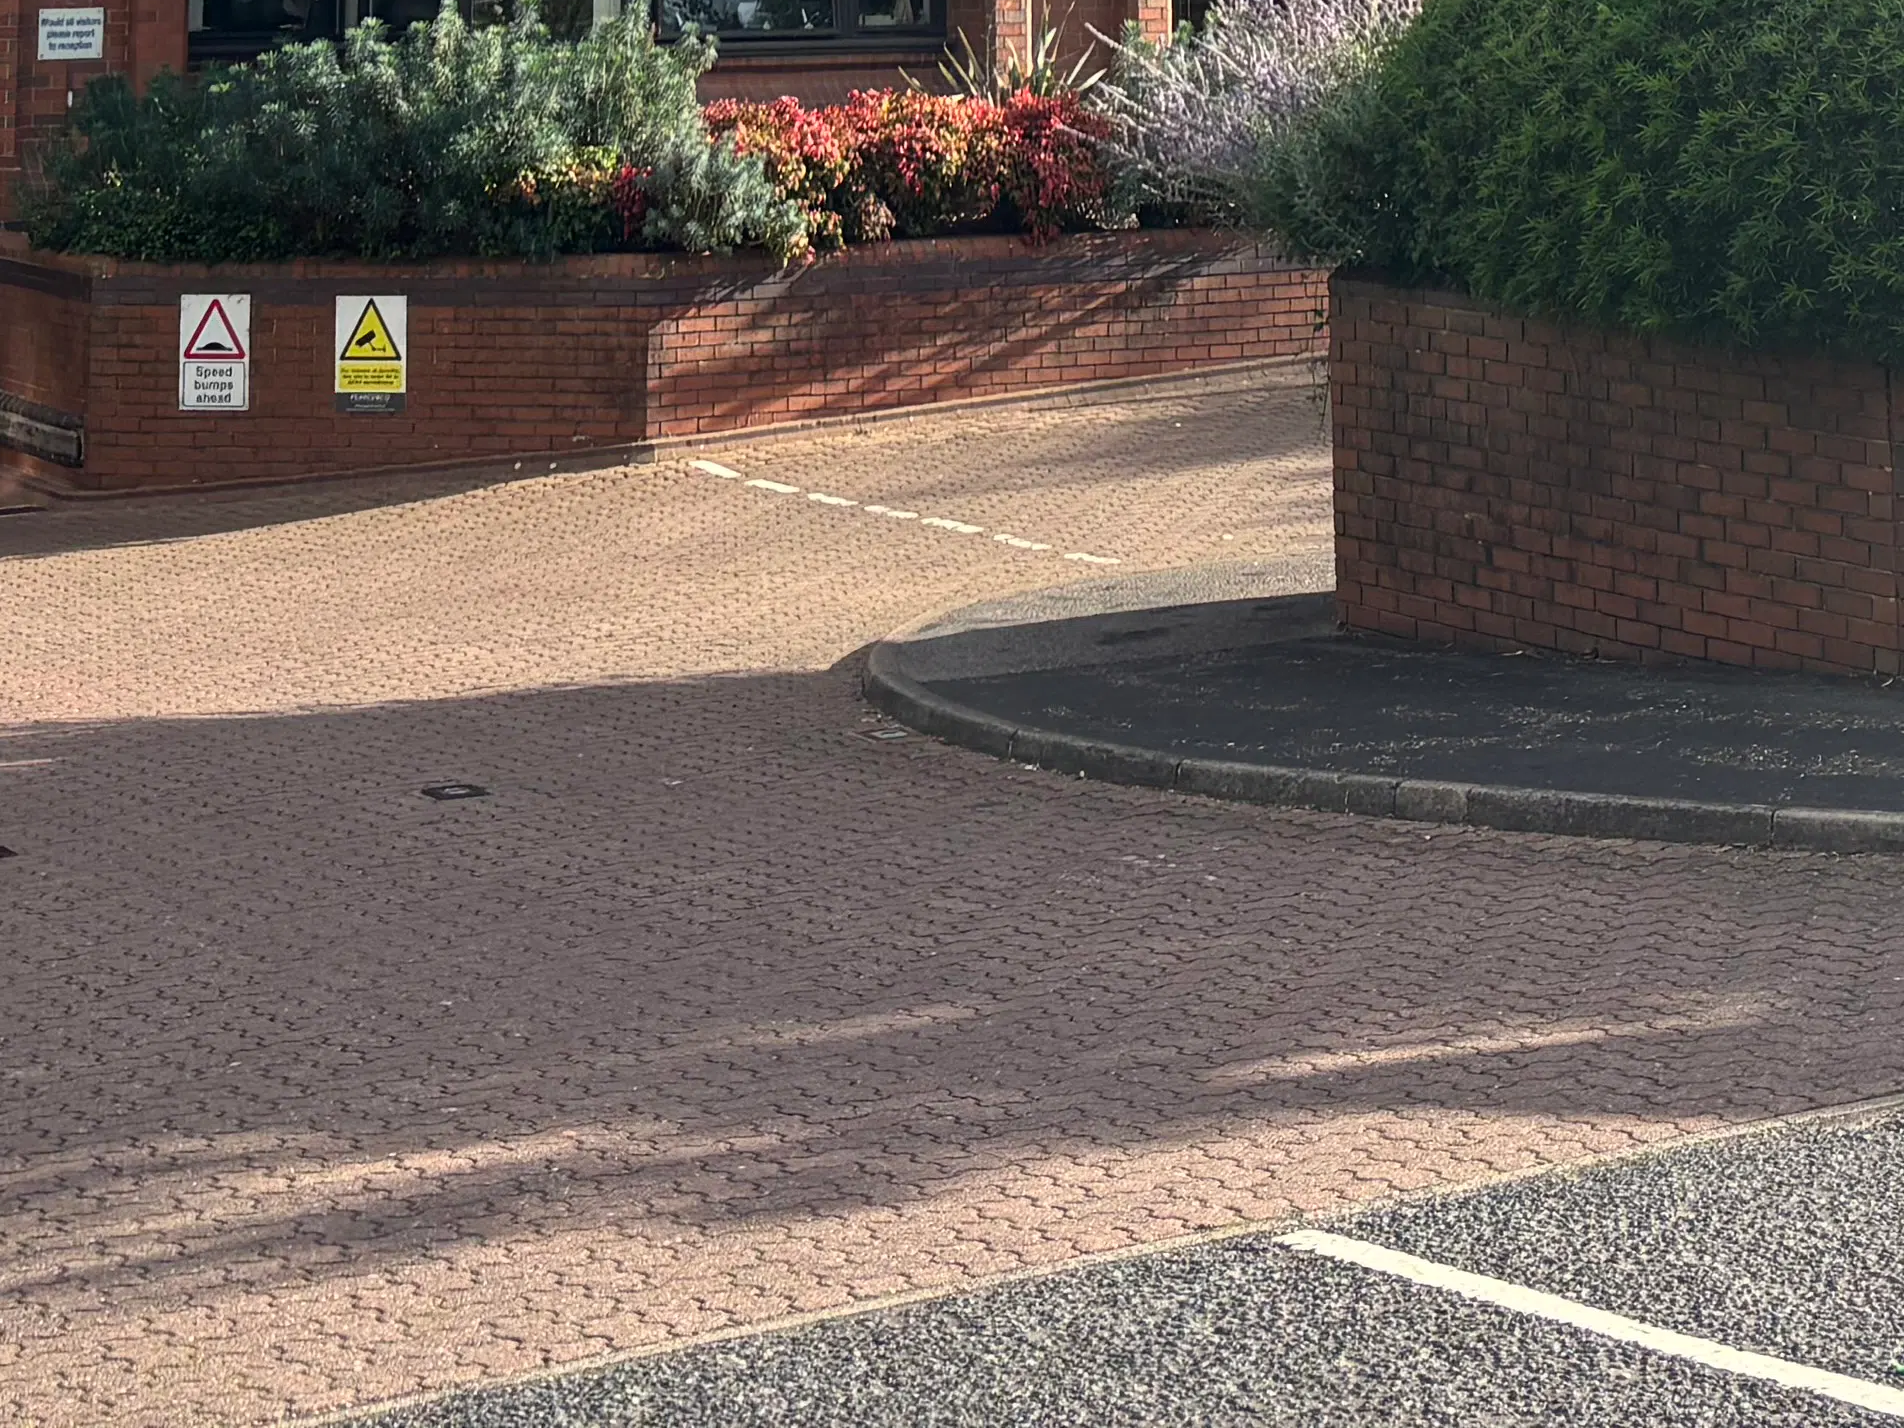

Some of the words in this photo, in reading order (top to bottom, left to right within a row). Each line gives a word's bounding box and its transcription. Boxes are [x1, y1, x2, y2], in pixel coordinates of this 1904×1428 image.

[196, 365, 232, 379] Speed
[194, 379, 233, 392] bumps
[196, 392, 231, 403] ahead
